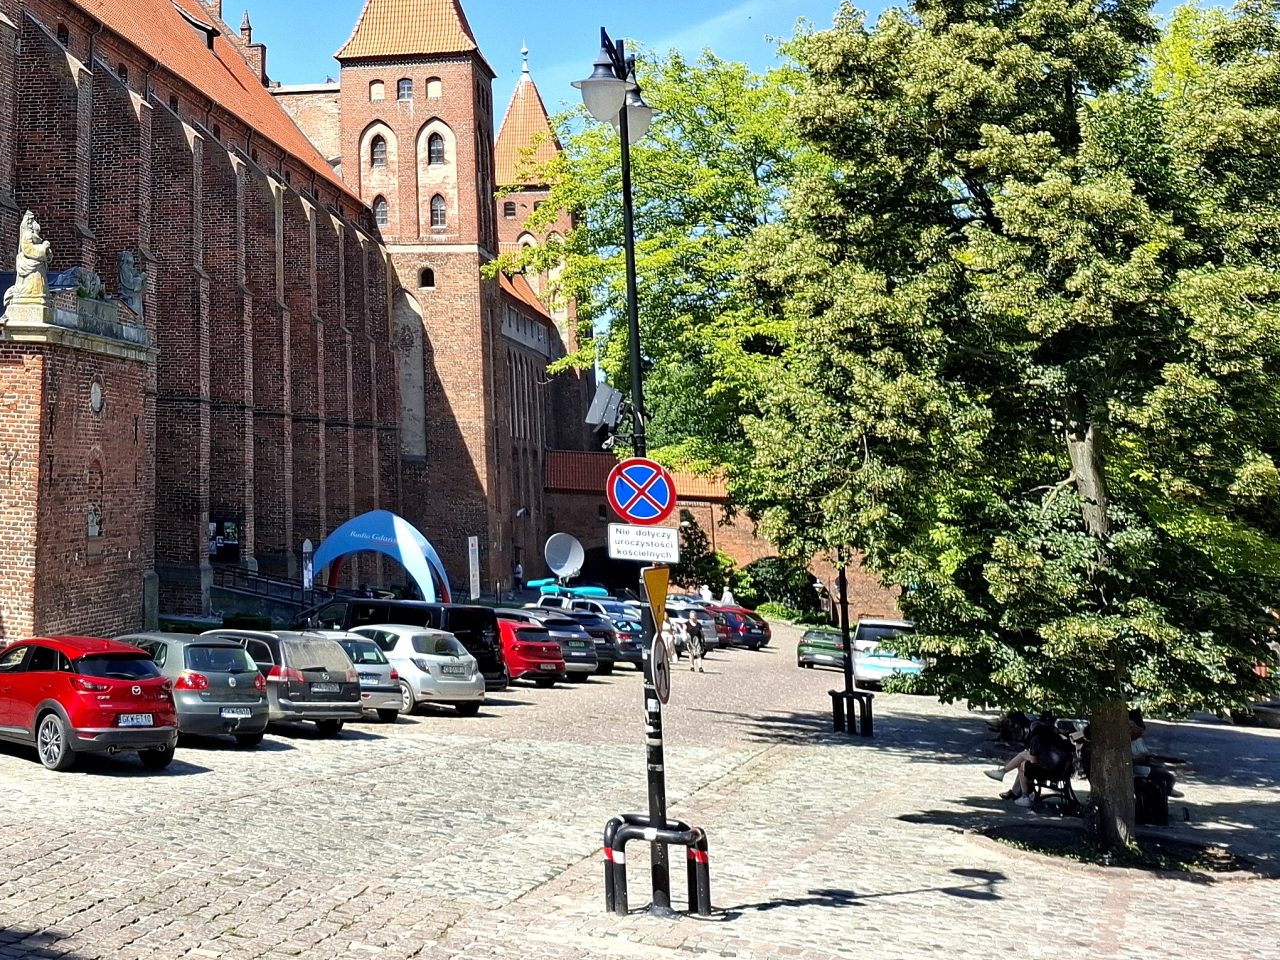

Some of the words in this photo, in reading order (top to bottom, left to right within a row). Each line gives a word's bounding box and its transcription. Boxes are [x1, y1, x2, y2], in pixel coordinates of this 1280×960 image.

[350, 530, 371, 539] Radio
[615, 527, 630, 535] Nie
[635, 529, 671, 539] dotyczy
[614, 539, 673, 548] uroczystości
[616, 548, 672, 559] kościelnych
